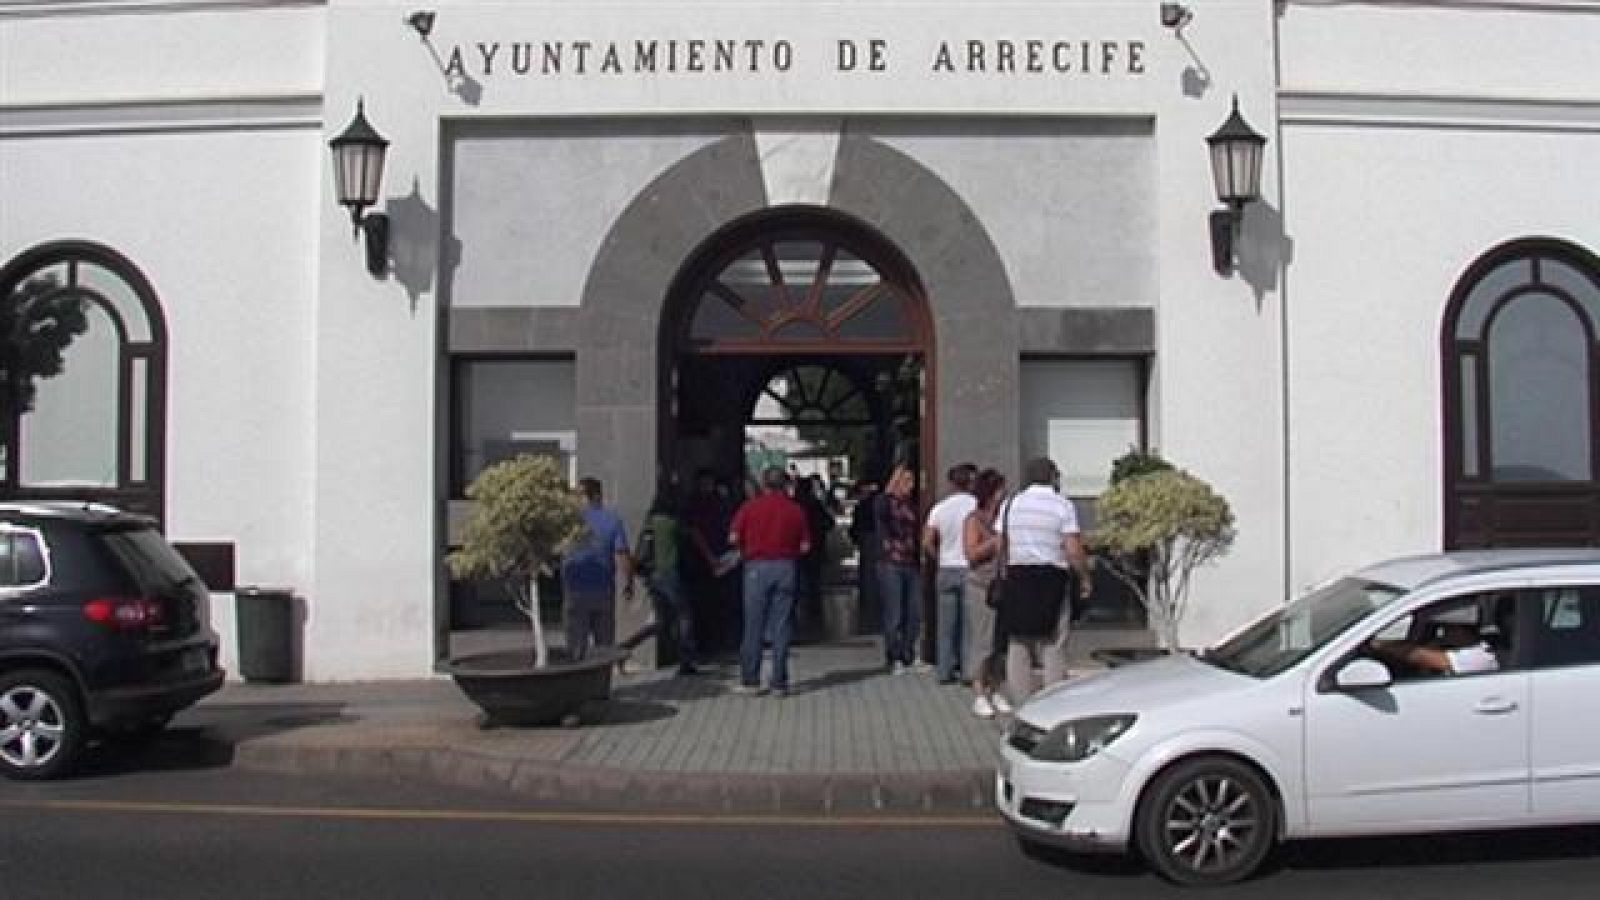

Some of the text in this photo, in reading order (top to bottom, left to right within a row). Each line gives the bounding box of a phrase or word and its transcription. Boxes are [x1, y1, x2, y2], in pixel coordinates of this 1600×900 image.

[445, 39, 1147, 76] AYUNTAMIENTO DE ARRECIFE
